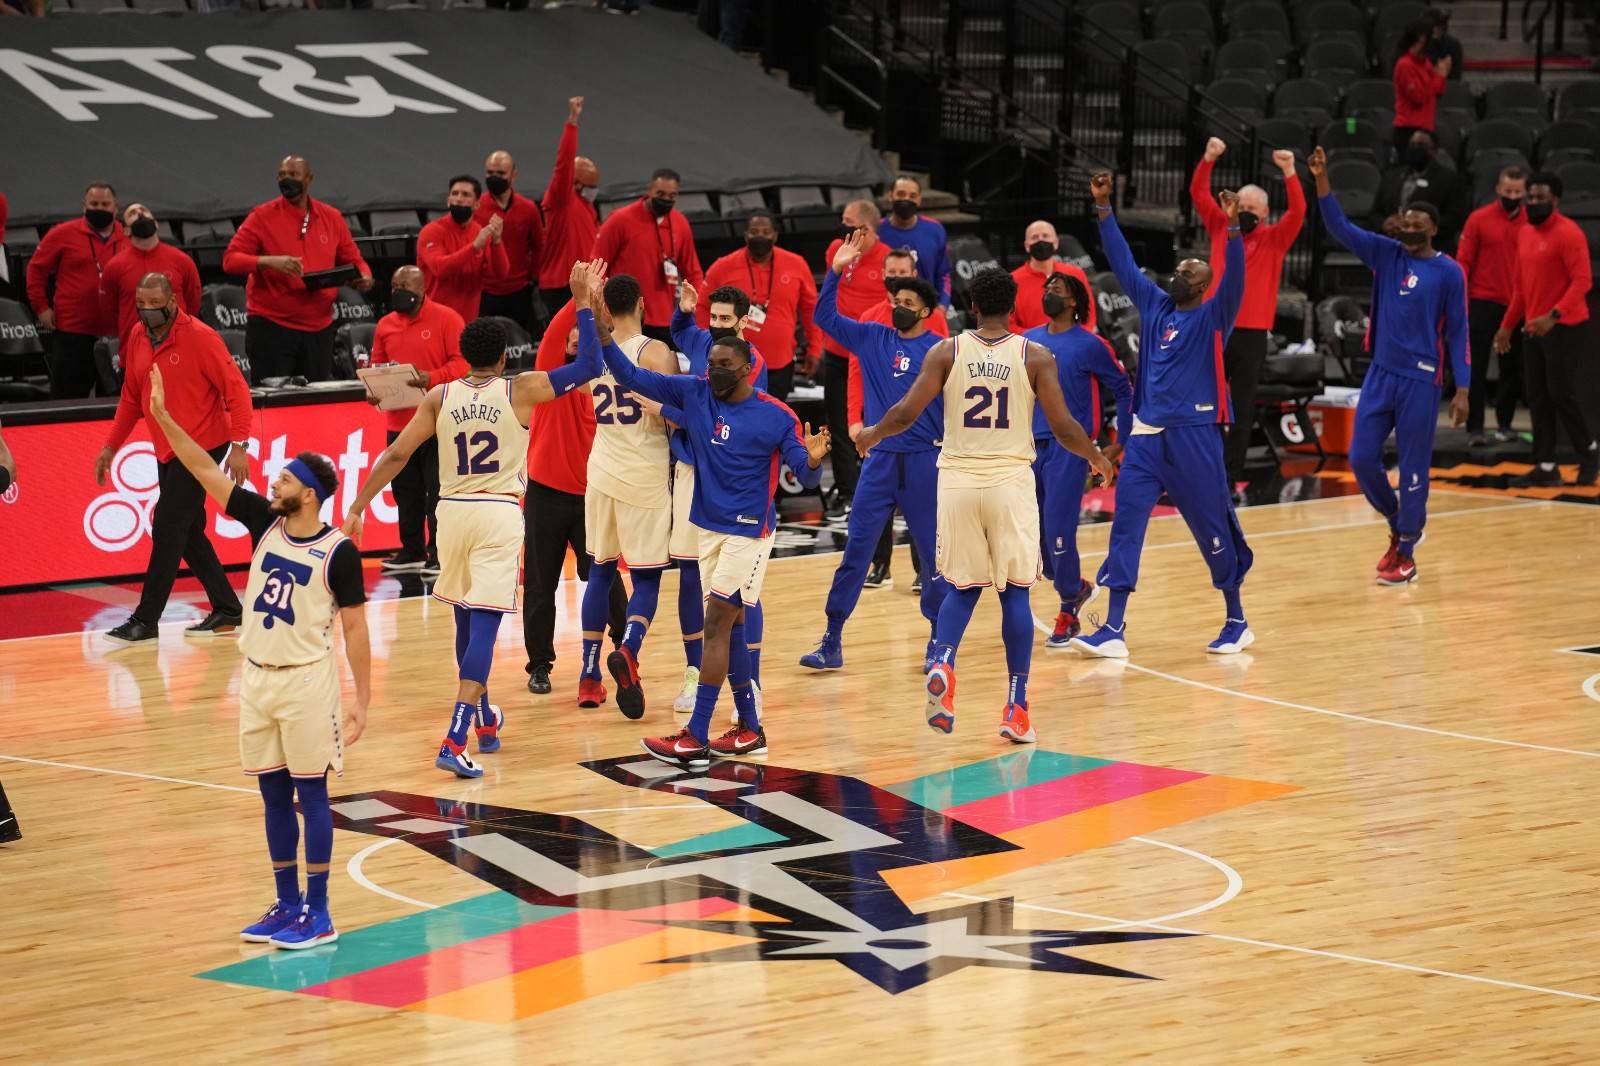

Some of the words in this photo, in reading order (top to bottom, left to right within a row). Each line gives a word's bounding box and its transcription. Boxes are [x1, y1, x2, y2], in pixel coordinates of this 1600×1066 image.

[0, 41, 506, 121] AT&T
[967, 361, 1011, 381] EMBIID
[450, 404, 502, 425] HARRIS
[592, 383, 643, 425] 25
[963, 385, 1010, 429] 21
[454, 430, 500, 476] 12
[263, 577, 293, 609] 31
